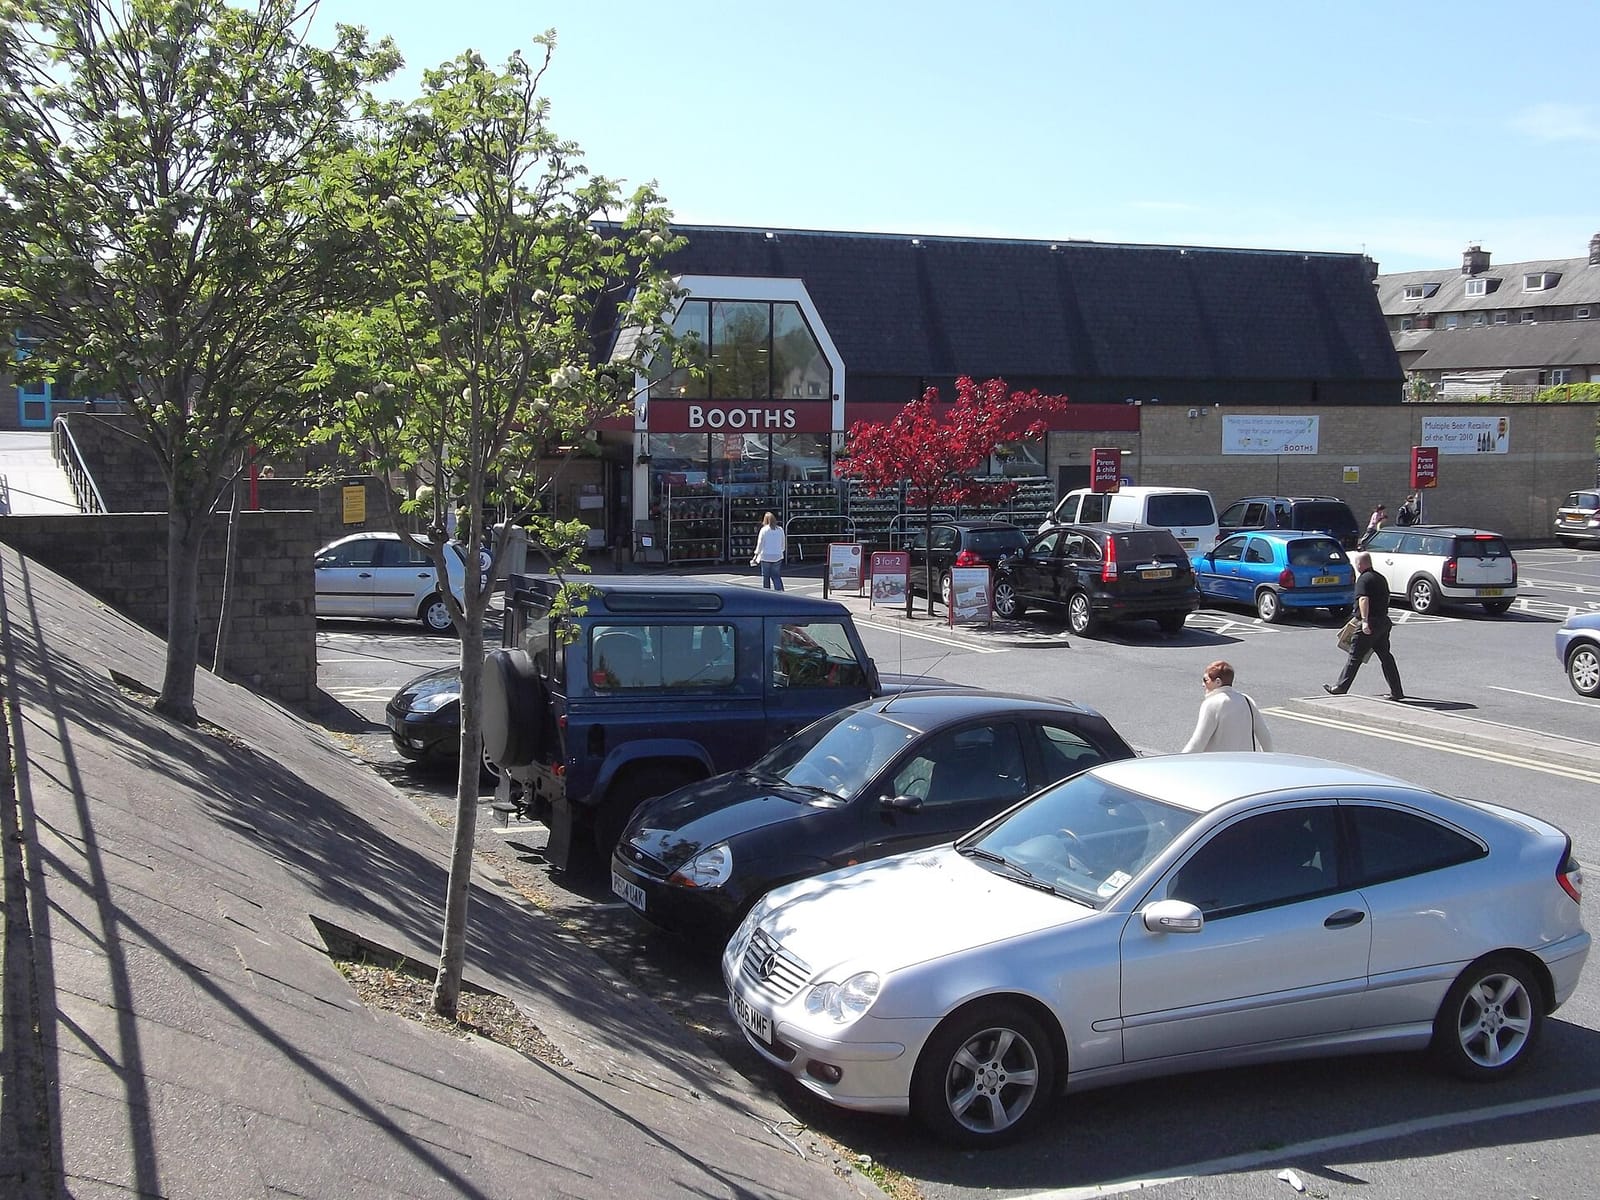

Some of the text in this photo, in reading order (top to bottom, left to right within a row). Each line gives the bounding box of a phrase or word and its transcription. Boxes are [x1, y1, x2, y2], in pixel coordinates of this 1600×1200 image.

[689, 405, 796, 428] BOOTHS
[1452, 422, 1466, 430] Beer
[1459, 433, 1473, 441] 2010
[1096, 474, 1117, 482] parking
[875, 557, 901, 565] 3 for 2
